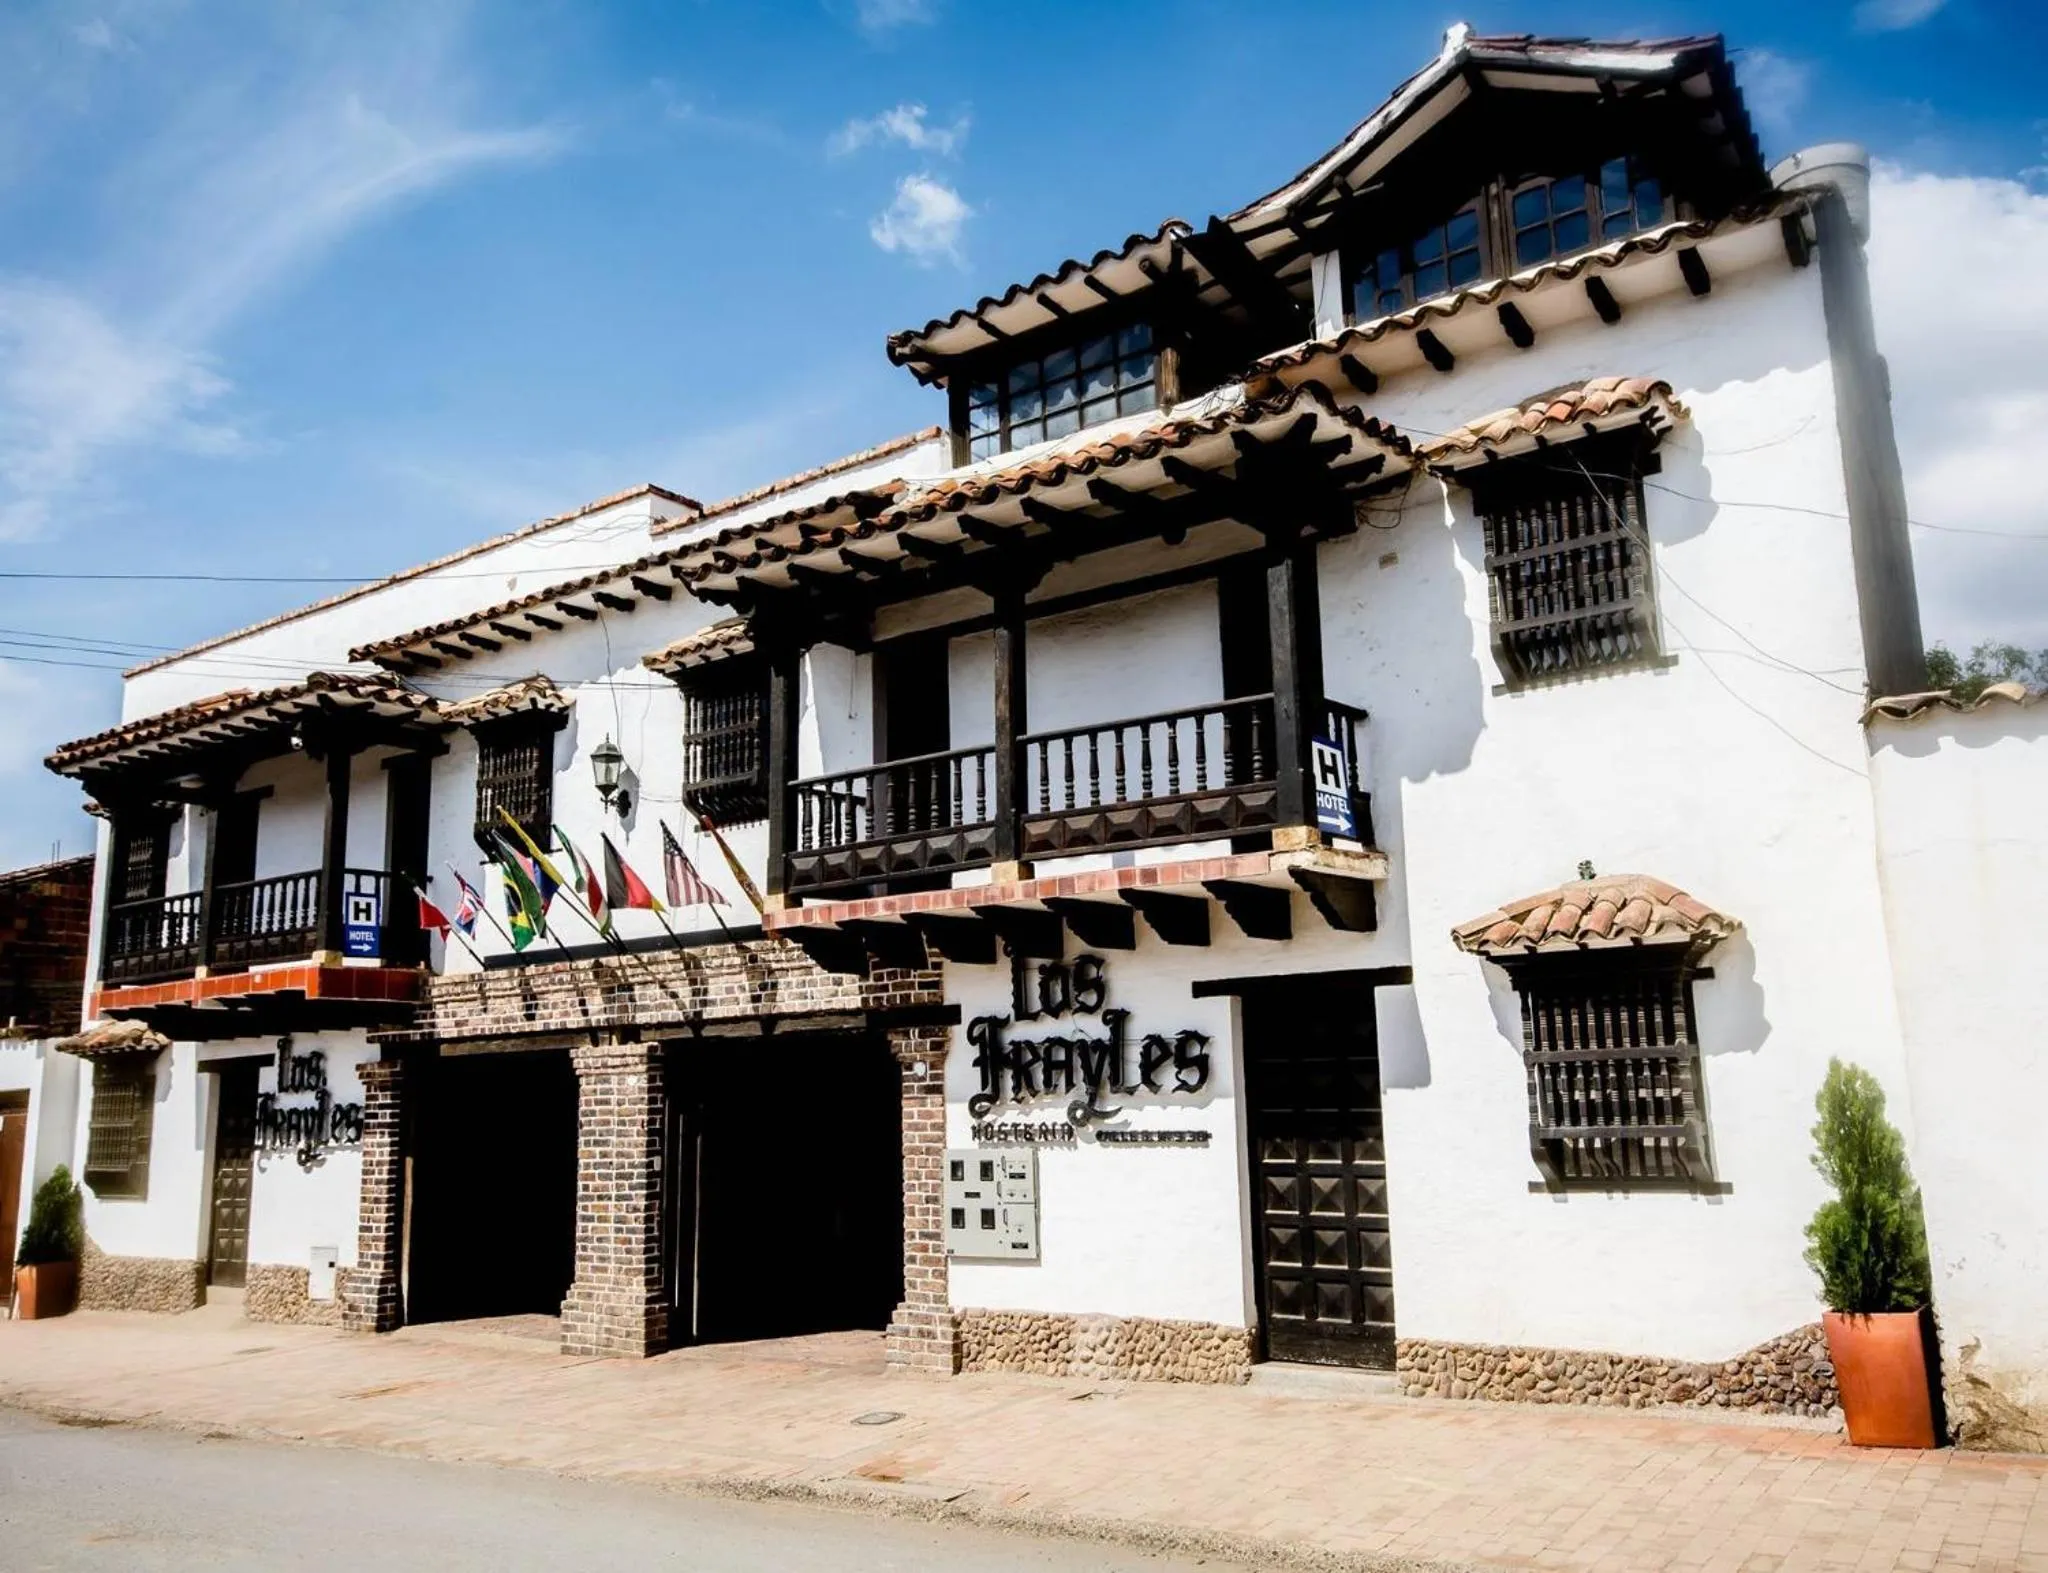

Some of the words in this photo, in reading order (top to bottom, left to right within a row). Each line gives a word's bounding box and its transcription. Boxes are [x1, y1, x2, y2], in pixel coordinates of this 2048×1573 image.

[1317, 747, 1342, 789] H
[1316, 791, 1351, 815] HOTEL
[353, 900, 372, 922] H
[348, 930, 376, 942] HOTEL
[970, 1121, 1076, 1143] HOSTERIA
